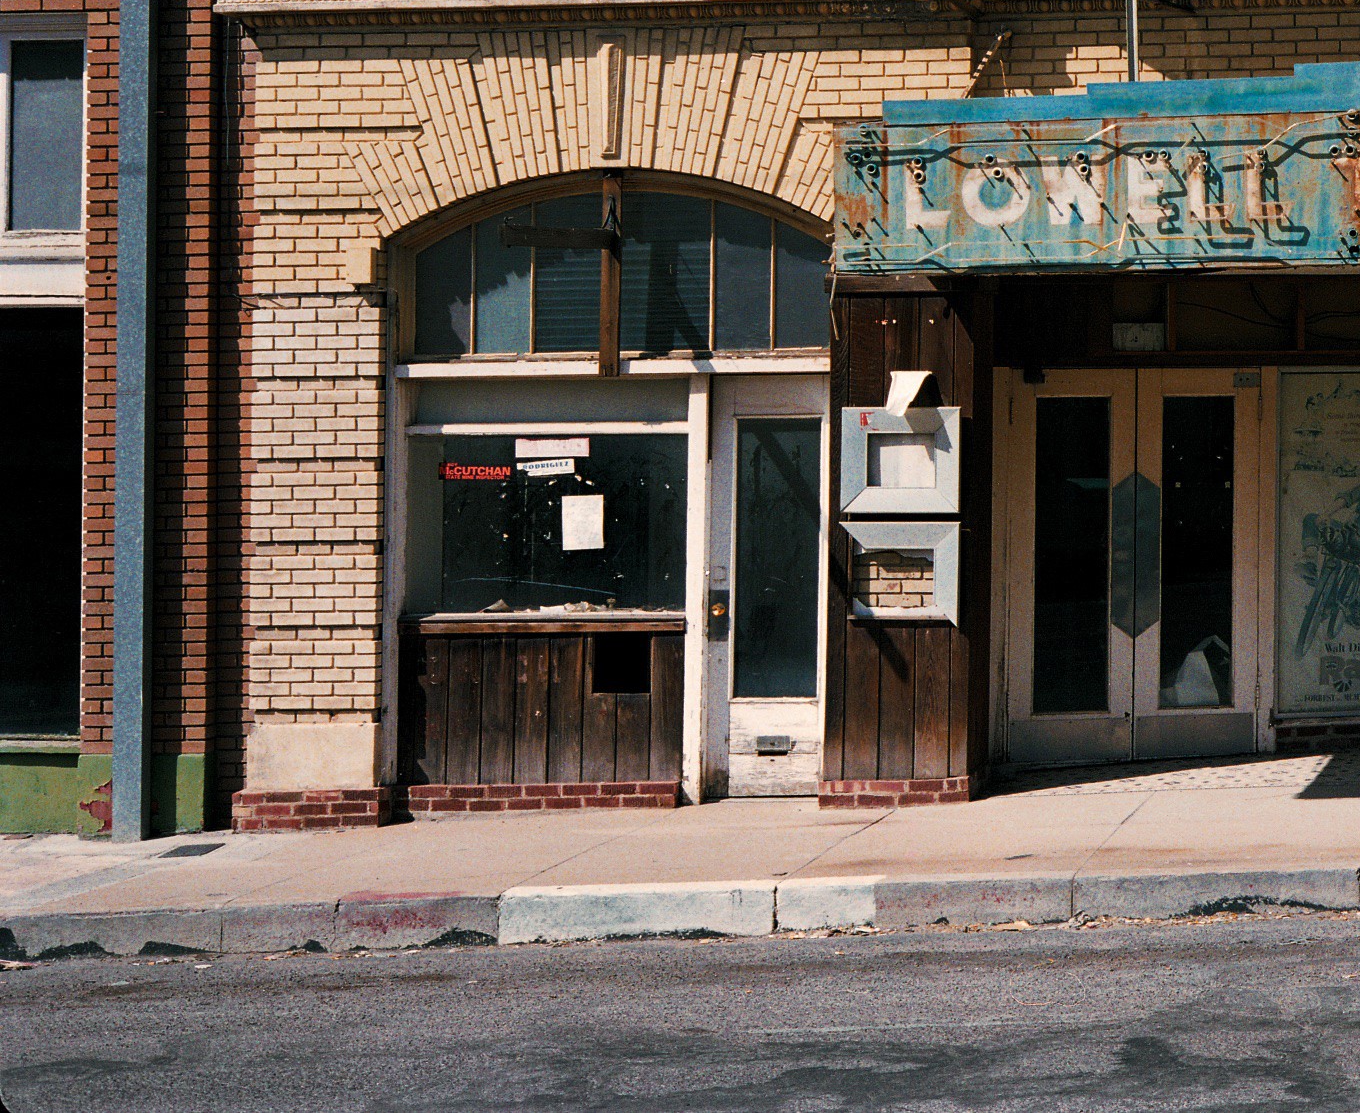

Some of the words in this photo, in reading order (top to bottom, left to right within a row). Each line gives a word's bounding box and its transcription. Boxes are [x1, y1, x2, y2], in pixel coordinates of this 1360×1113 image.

[904, 152, 1297, 230] LOWELL
[439, 466, 511, 476] McCUTCHAN
[1324, 643, 1346, 653] Walt
